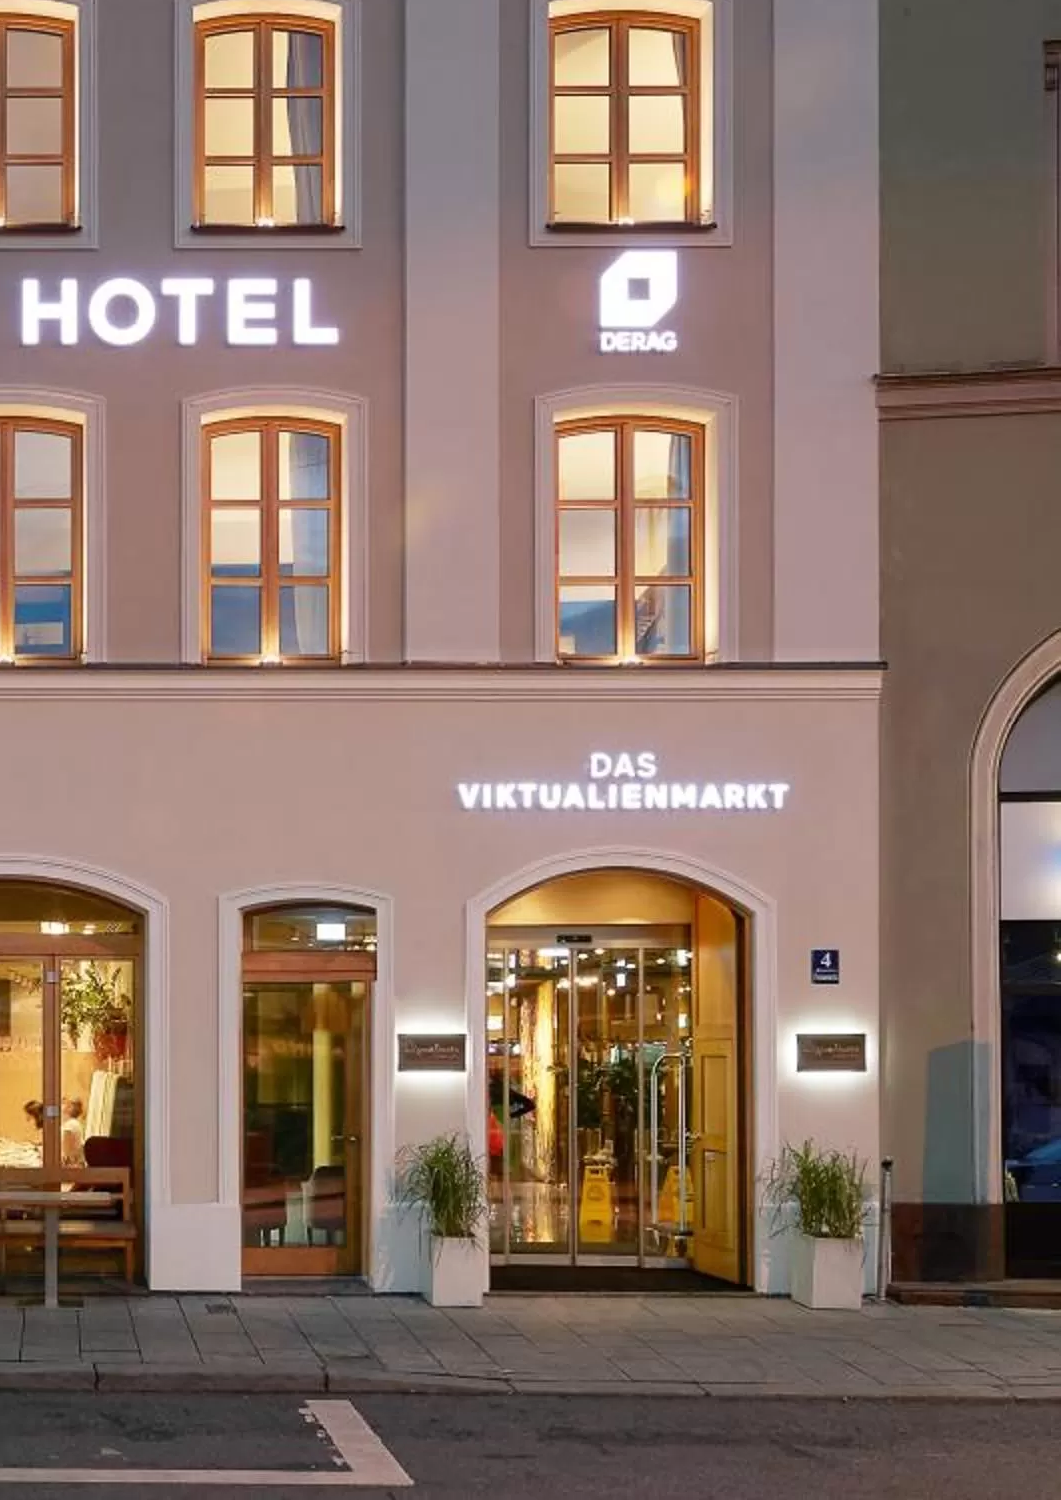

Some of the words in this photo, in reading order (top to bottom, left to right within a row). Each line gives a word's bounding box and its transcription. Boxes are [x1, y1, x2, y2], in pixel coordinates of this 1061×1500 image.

[21, 277, 340, 346] HOTEL
[600, 331, 678, 353] DERAG
[589, 752, 658, 779] DAS
[457, 783, 791, 810] VIKTUALIENMARKT
[820, 951, 832, 968] 4
